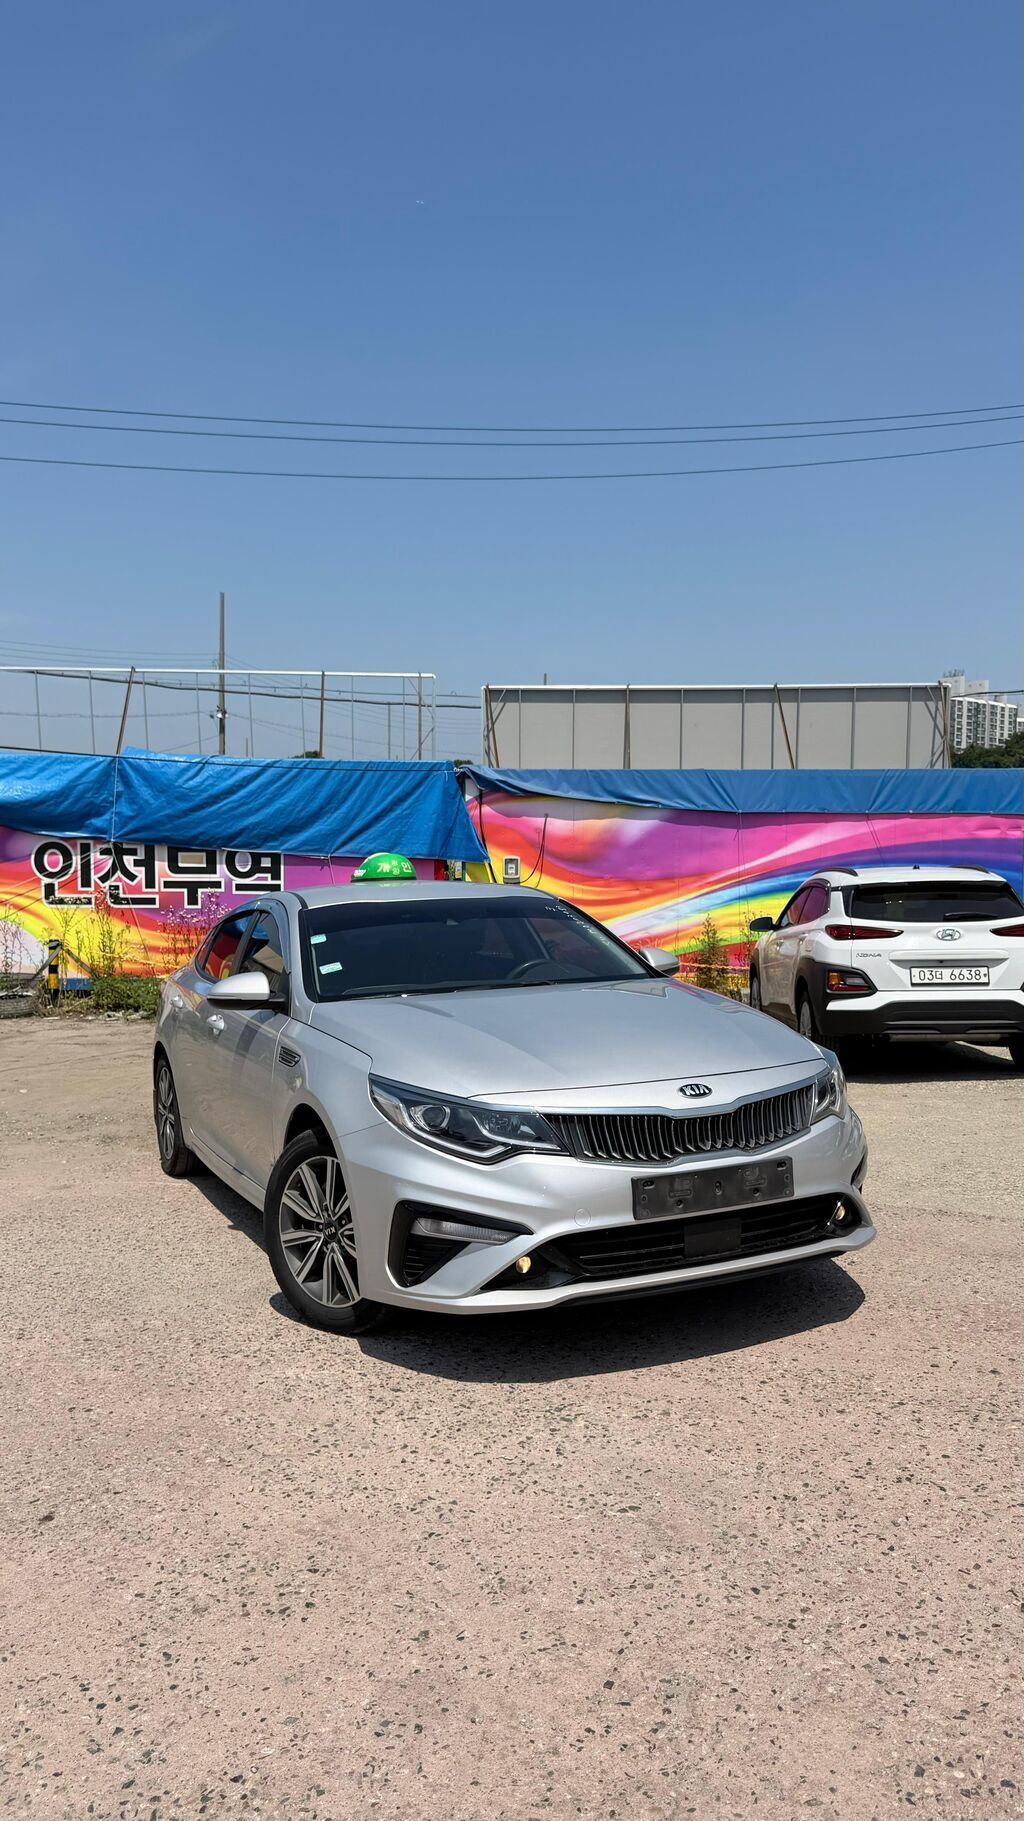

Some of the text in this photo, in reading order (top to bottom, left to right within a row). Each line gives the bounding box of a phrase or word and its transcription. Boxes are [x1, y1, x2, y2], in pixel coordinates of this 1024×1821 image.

[33, 840, 283, 907] 인천무역
[918, 969, 982, 981] 03더 6638
[682, 1084, 710, 1096] KIA
